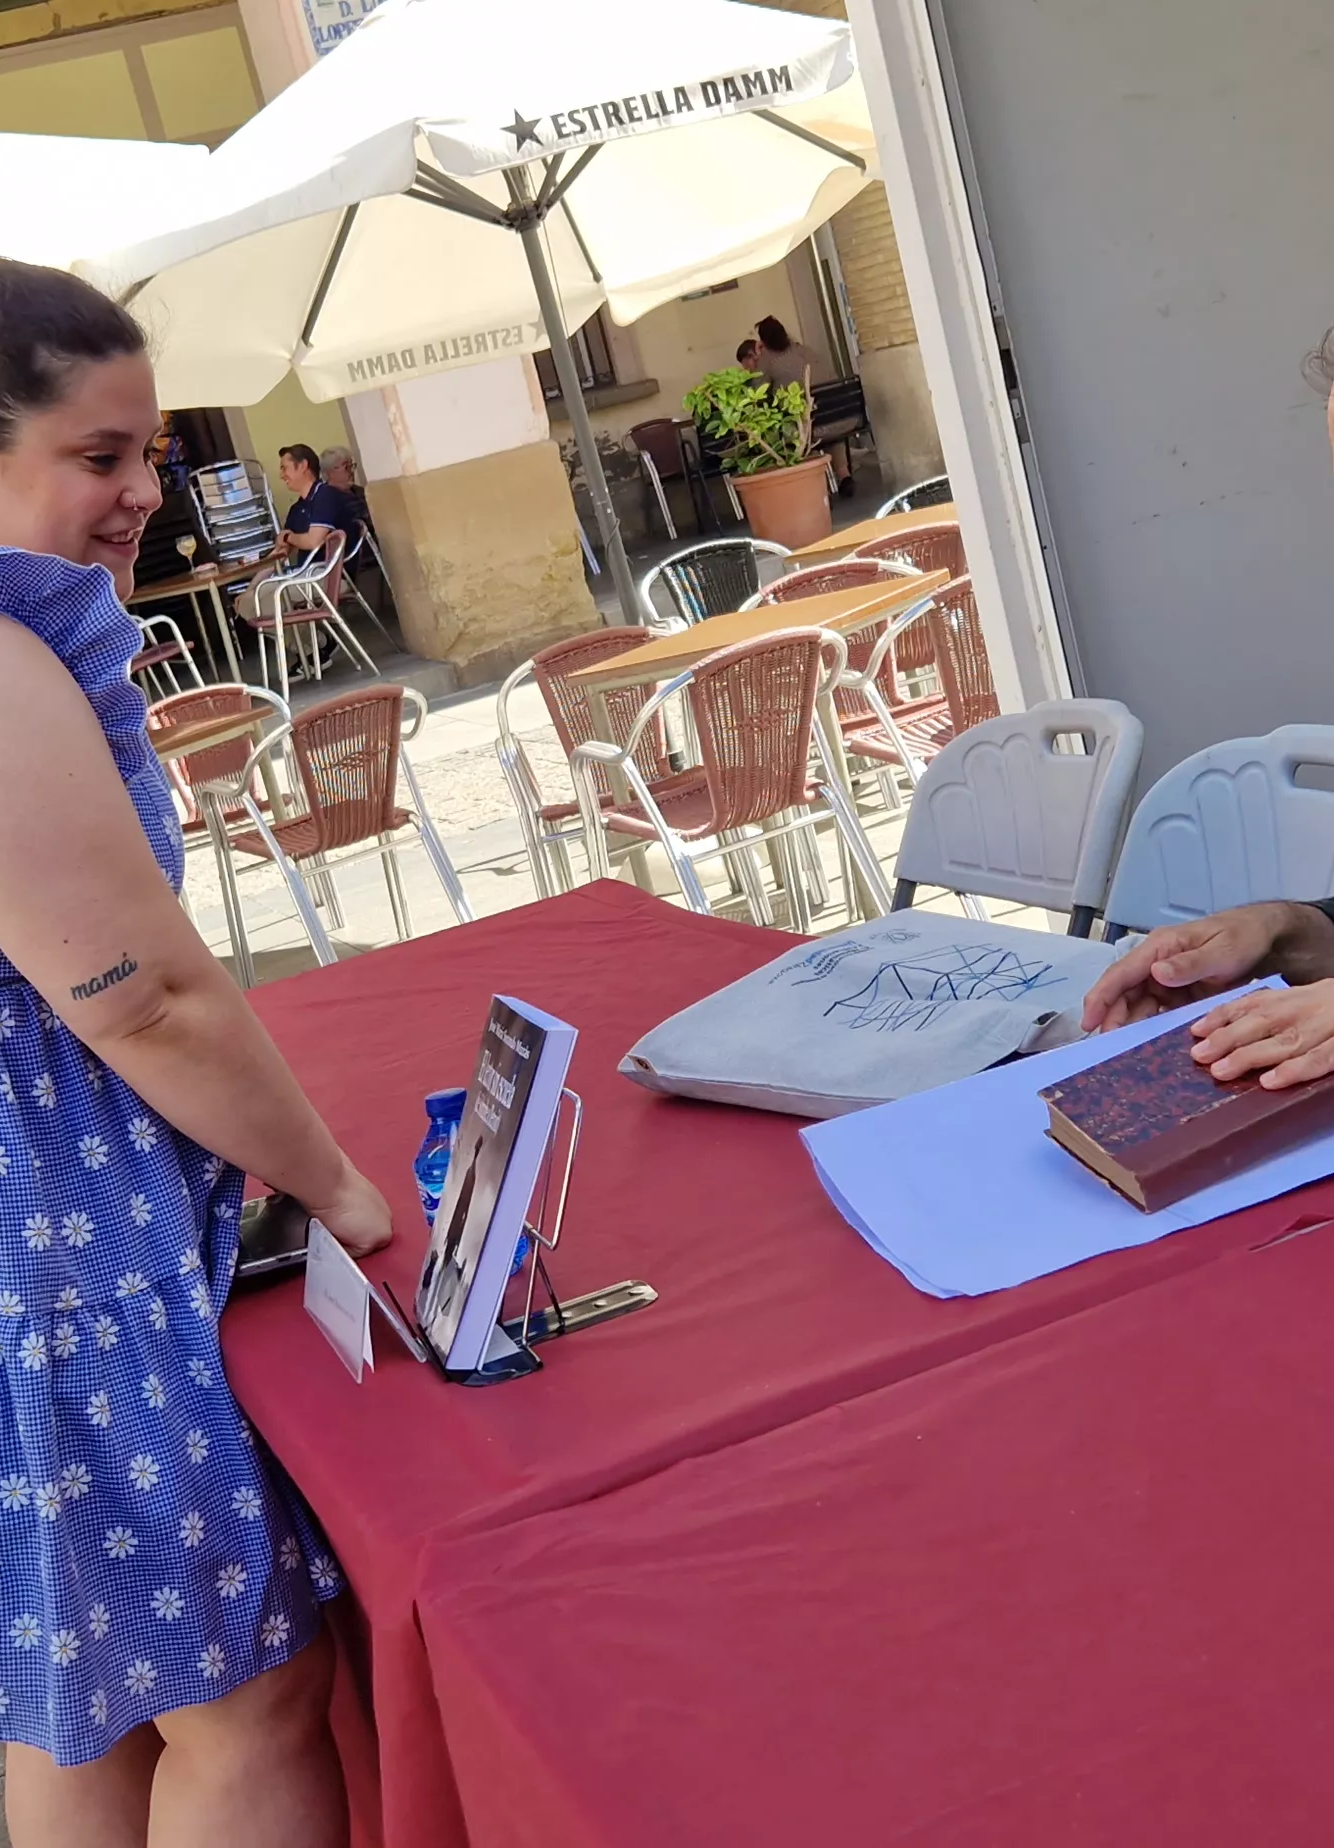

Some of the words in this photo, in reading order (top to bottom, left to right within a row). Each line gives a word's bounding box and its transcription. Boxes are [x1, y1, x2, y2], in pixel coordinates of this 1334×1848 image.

[550, 86, 694, 140] ESTRELLA
[699, 65, 793, 108] DAMM
[70, 952, 138, 1000] mamá
